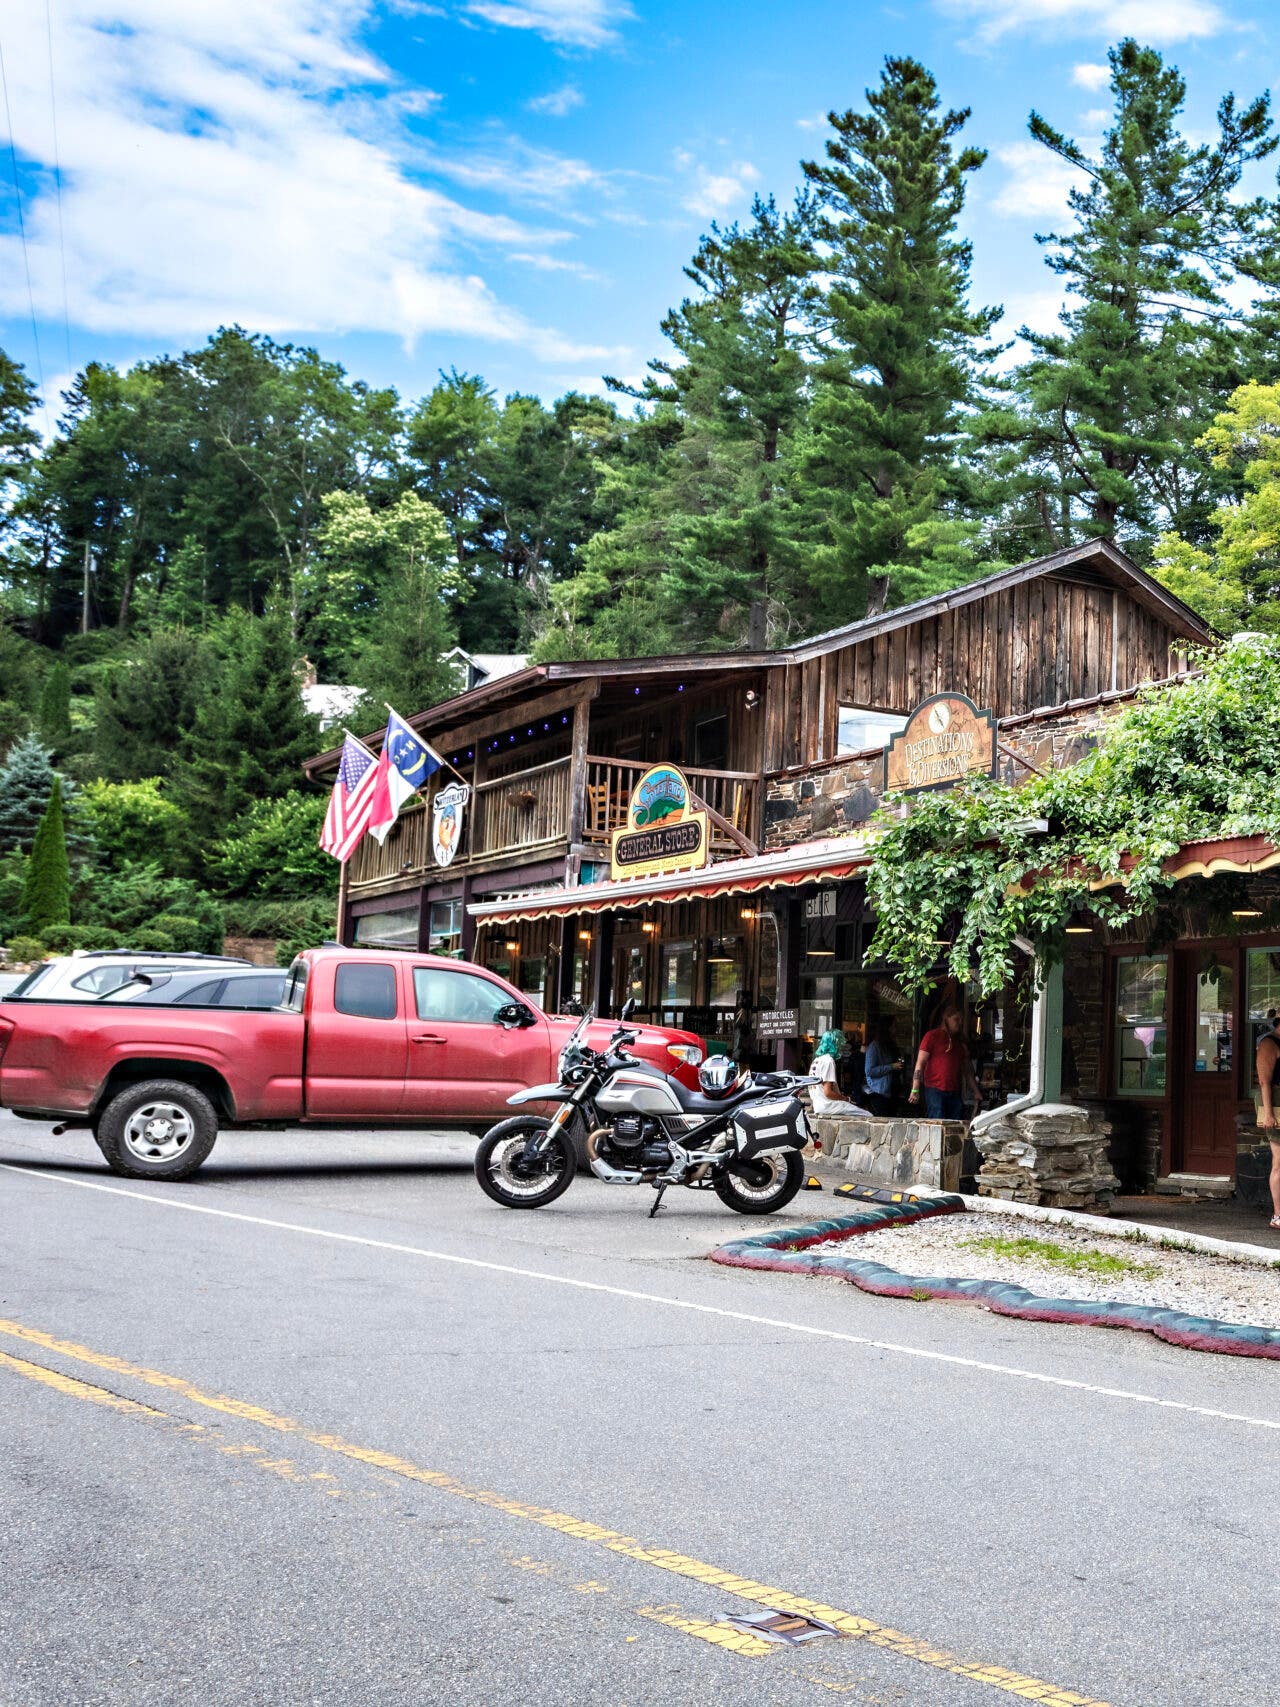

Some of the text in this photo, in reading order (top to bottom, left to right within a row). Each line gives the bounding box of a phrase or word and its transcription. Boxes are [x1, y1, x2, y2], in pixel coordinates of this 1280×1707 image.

[905, 733, 974, 767] DESTINATIONS
[621, 827, 695, 859] GENERAL STORE
